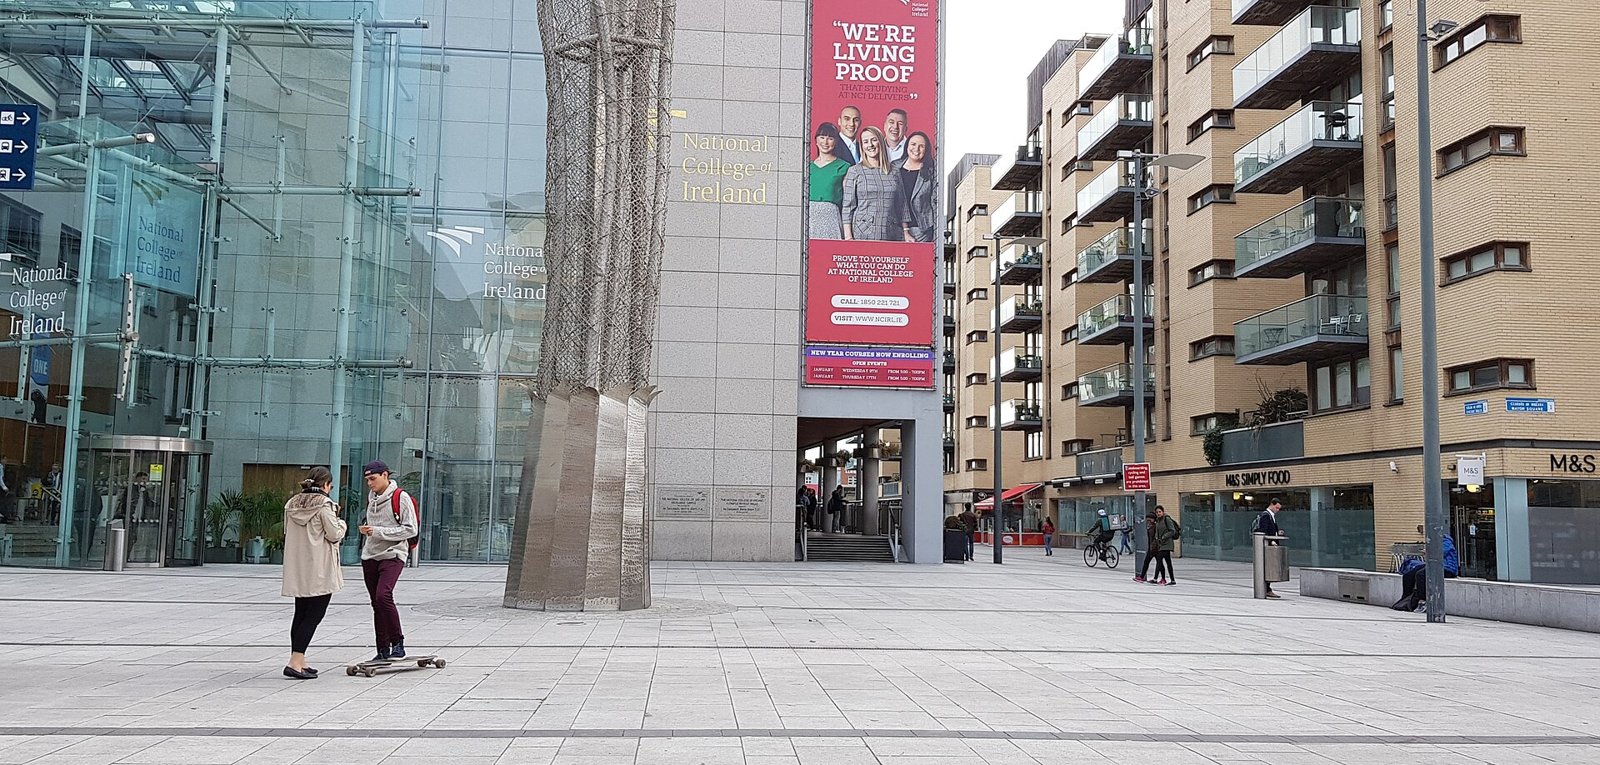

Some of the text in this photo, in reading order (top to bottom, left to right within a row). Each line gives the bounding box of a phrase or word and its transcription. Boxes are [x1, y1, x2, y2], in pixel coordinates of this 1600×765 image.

[832, 20, 916, 43] “WE’RE
[833, 42, 915, 63] LIVING
[835, 62, 914, 83] PROOF
[838, 91, 851, 99] AT
[851, 92, 867, 100] NCI
[840, 83, 908, 94] THAT STUDYING
[683, 132, 769, 153] National
[682, 156, 773, 180] College of
[681, 181, 767, 205] Ireland
[138, 215, 184, 243] National
[137, 236, 176, 262] College
[484, 242, 543, 258] Nationa
[832, 254, 858, 262] PROVE
[870, 256, 910, 264] YOURSELF
[11, 262, 68, 285] National
[135, 255, 181, 283] Ireland
[484, 261, 538, 279] College
[860, 262, 876, 270] YOU
[894, 263, 906, 271] DO
[878, 269, 914, 277] COLLEGE
[859, 276, 894, 284] IRELAND
[9, 287, 68, 311] College of
[482, 281, 547, 300] Ireland
[8, 312, 66, 335] Ireland
[33, 358, 48, 376] ONE
[1463, 467, 1479, 475] M&S
[1549, 453, 1597, 473] M&S
[1225, 469, 1291, 487] M&S SIMPLY FOOD
